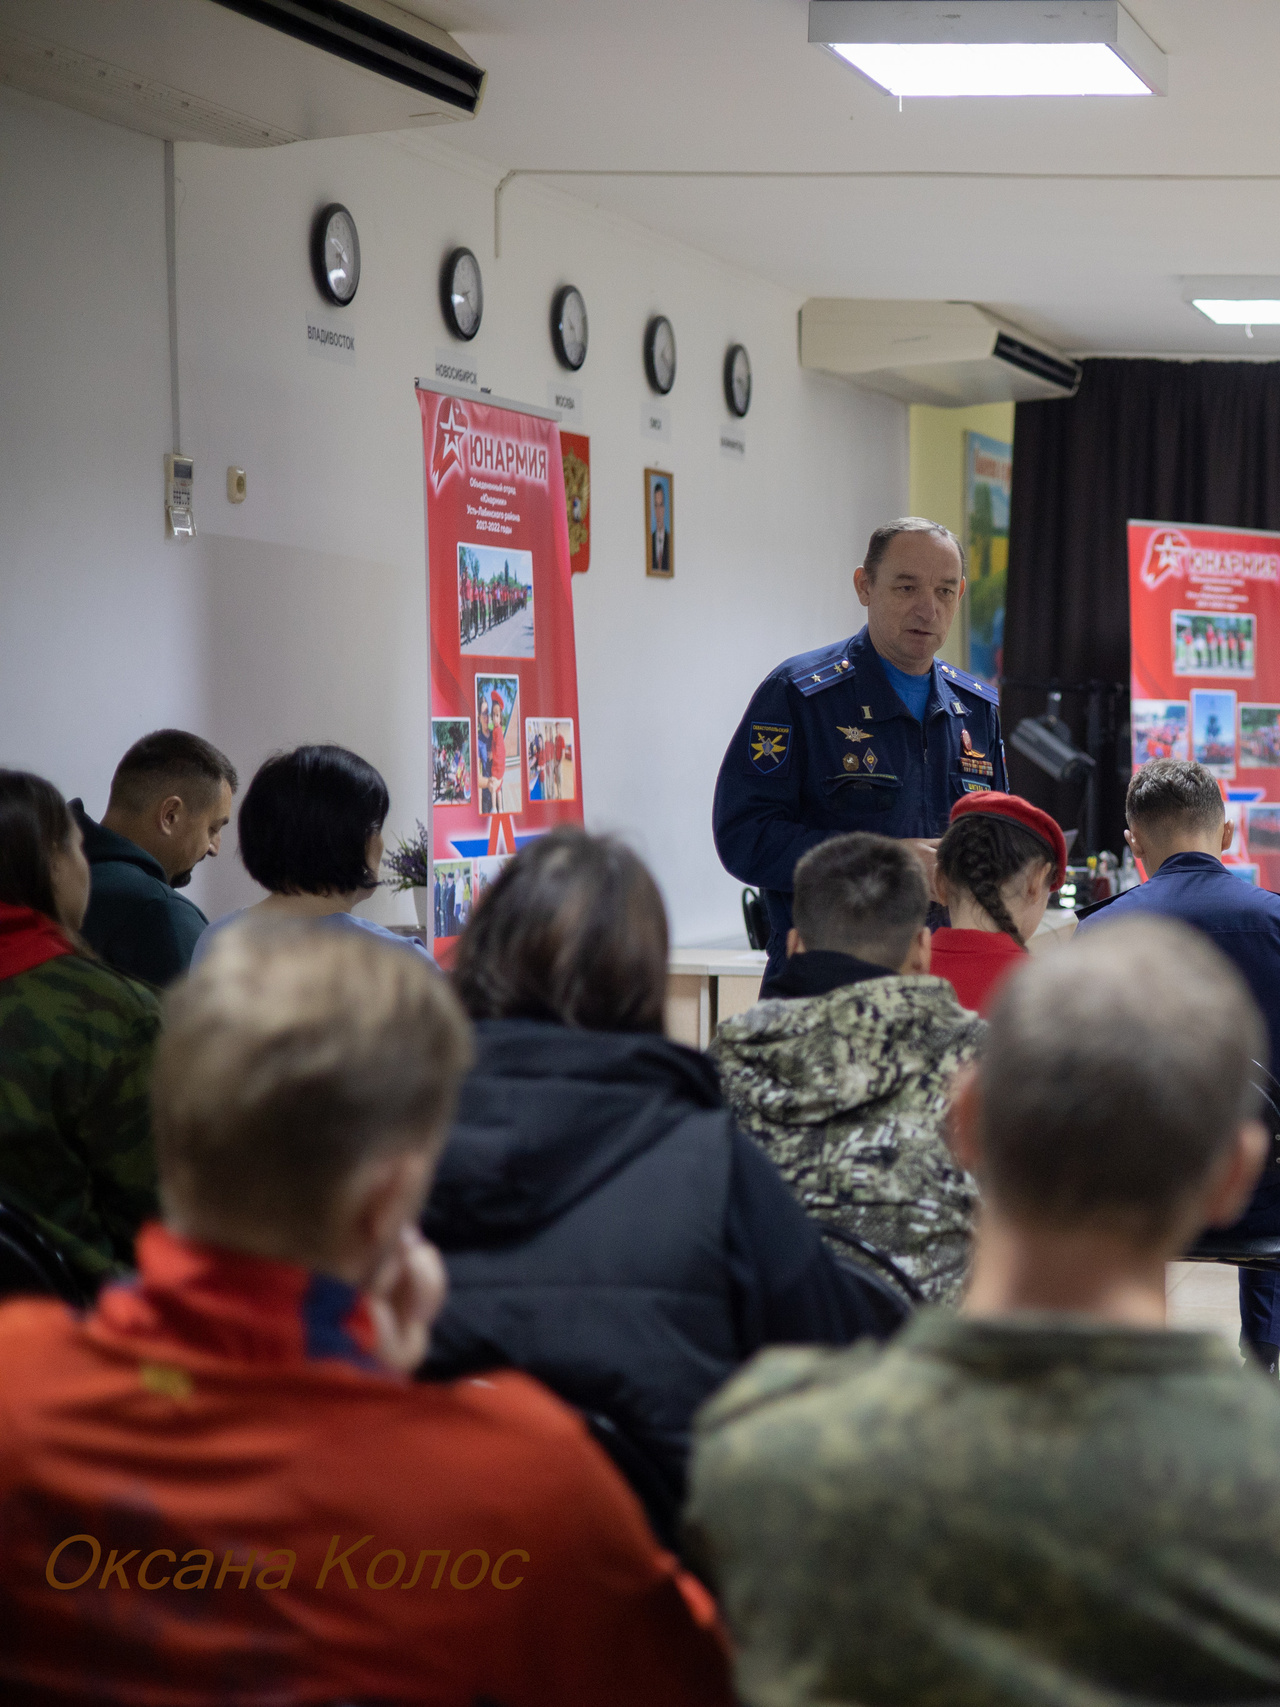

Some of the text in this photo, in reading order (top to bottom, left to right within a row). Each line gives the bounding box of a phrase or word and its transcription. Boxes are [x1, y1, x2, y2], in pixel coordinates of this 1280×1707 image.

[307, 325, 355, 351] ВЛАДИВОСТОК
[435, 362, 477, 386] НОВОСИБИРСК
[469, 433, 547, 481] ЮНАРМИЯ
[1188, 550, 1279, 578] ЮНАРМИЯ
